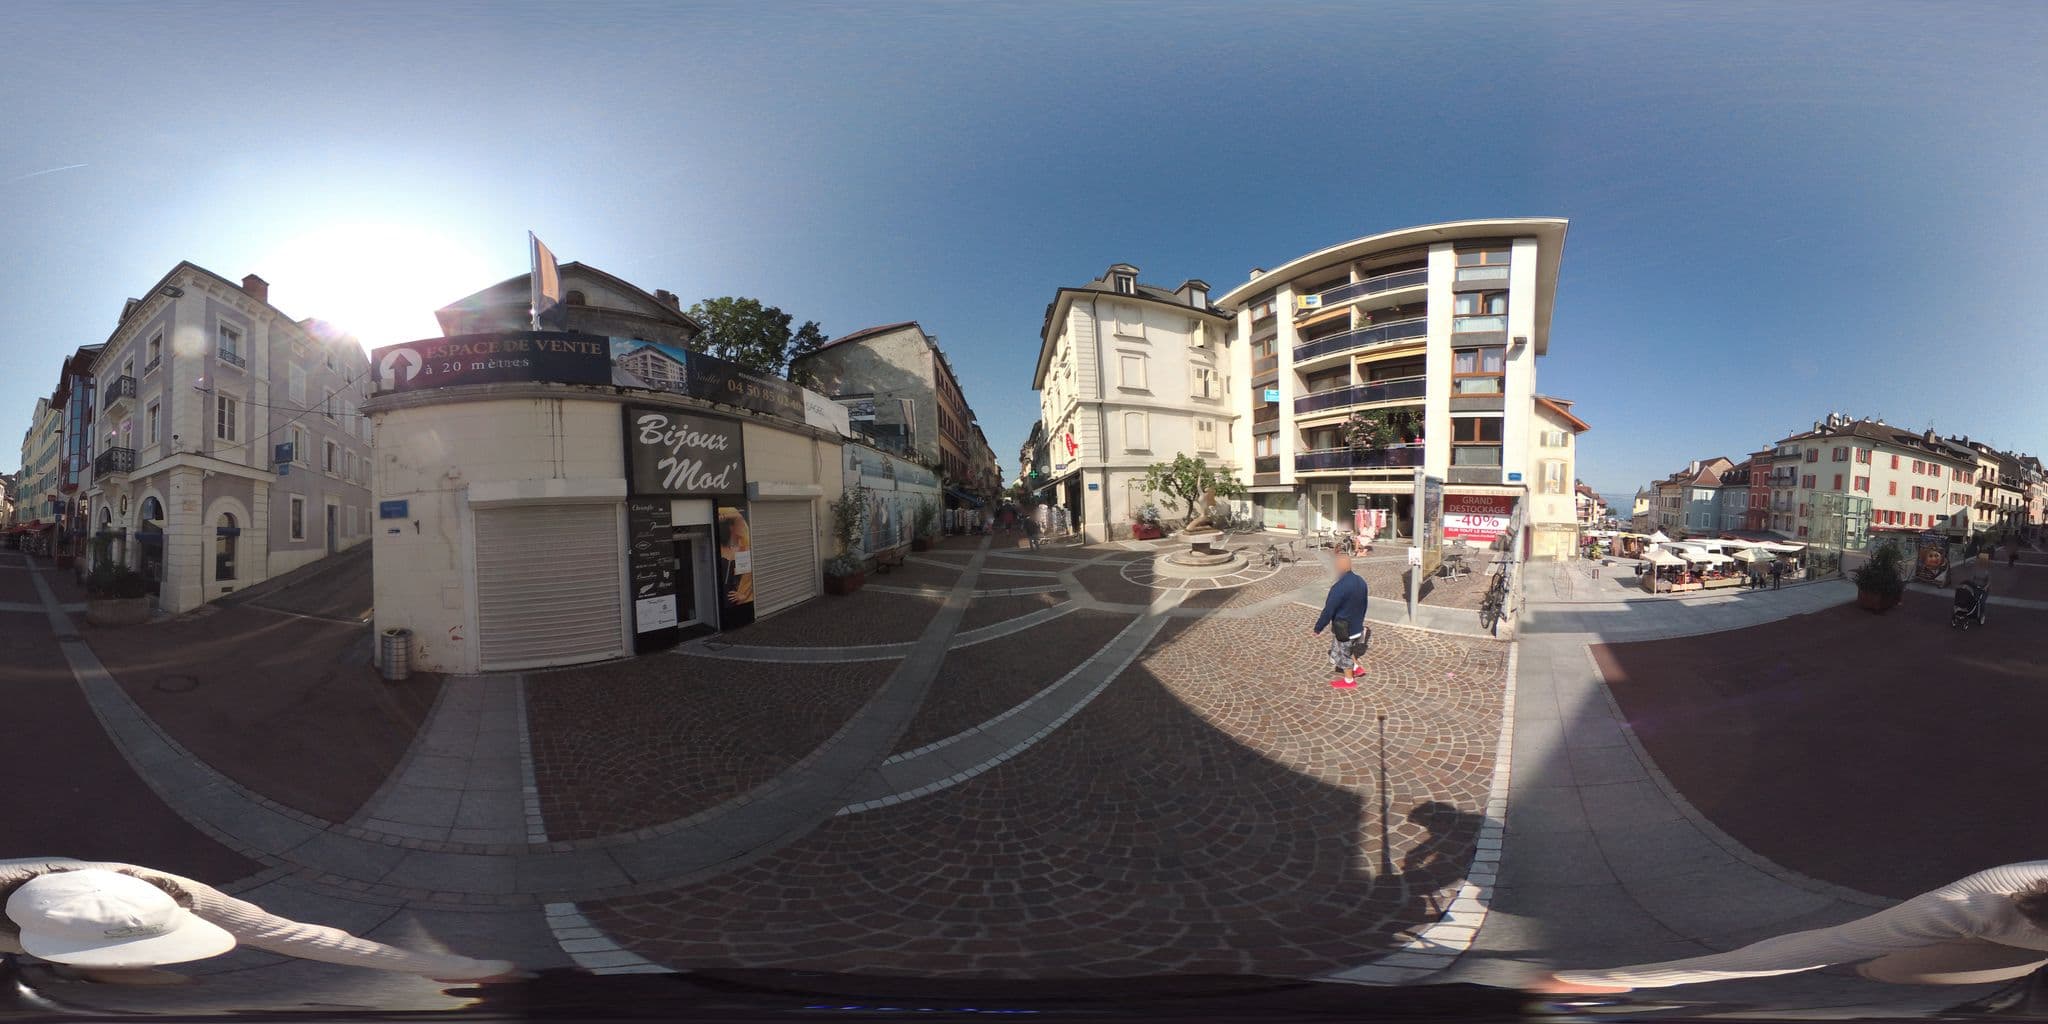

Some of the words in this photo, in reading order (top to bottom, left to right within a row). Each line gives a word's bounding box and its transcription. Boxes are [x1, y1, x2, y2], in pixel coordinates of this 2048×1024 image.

[423, 341, 498, 359] ESPACE
[503, 340, 529, 352] DE
[536, 340, 602, 355] VENTE
[425, 365, 433, 375] à
[442, 362, 461, 373] 20
[471, 358, 529, 370] mètres
[728, 379, 744, 394] 04
[746, 384, 760, 398] 50
[637, 414, 728, 455] Bijoux
[658, 457, 737, 491] Mod'
[1449, 504, 1506, 514] DESTOCKAGE
[1462, 496, 1493, 505] GRAND
[1455, 514, 1499, 528] -40%
